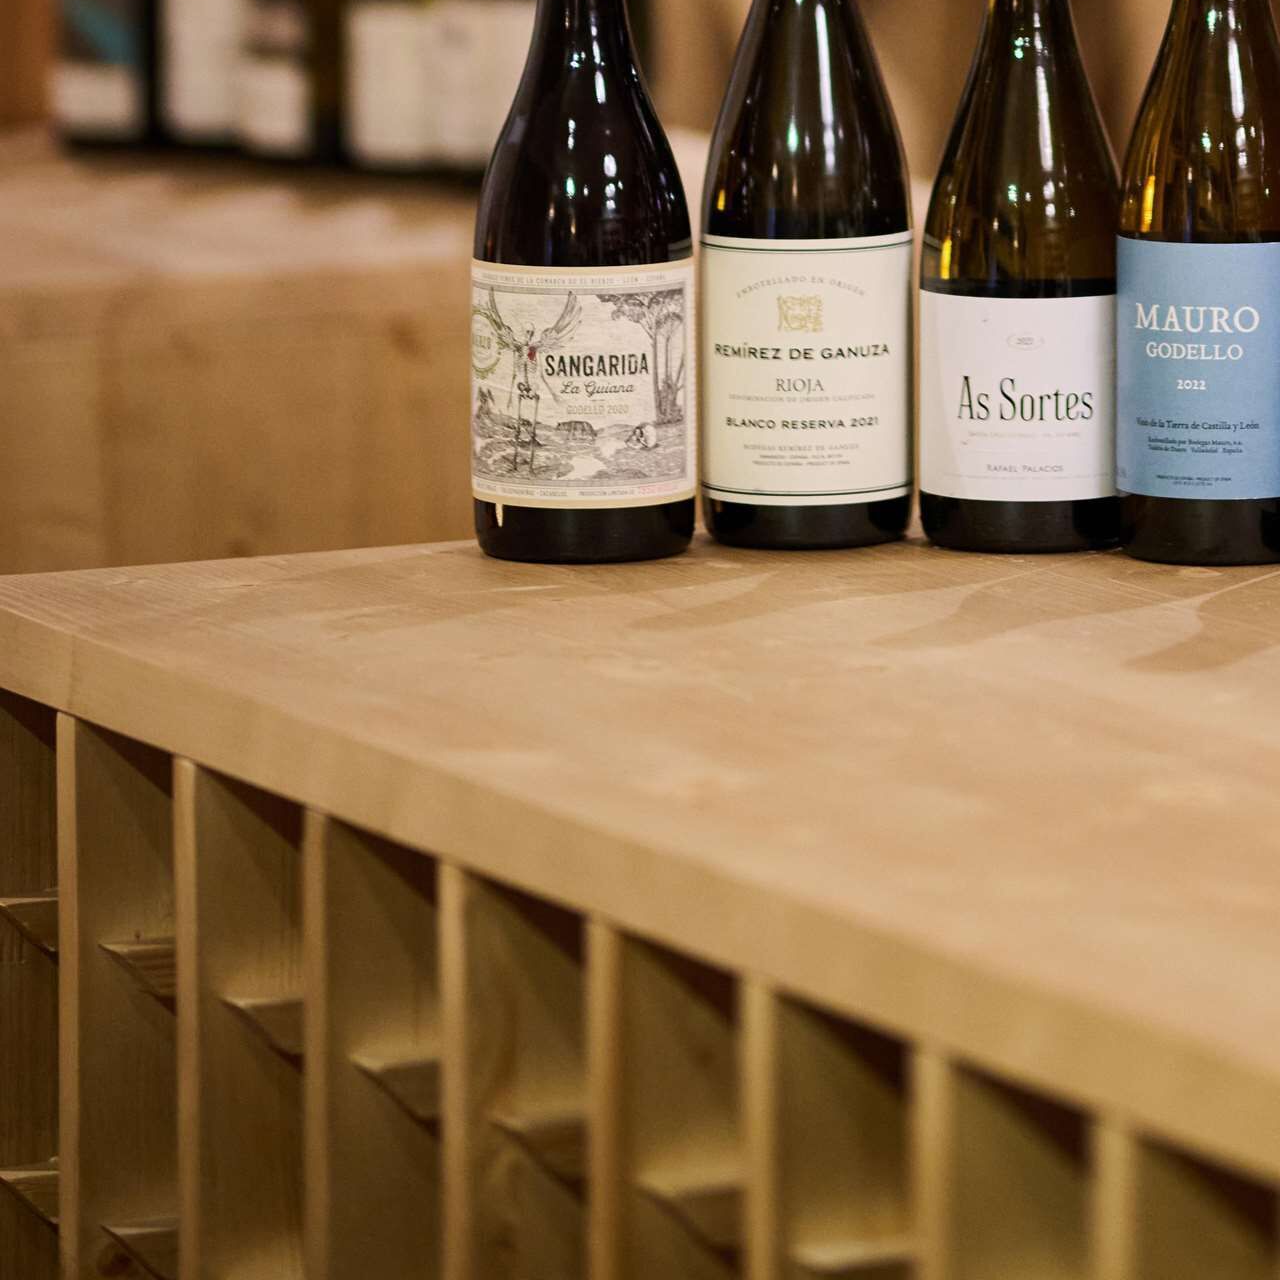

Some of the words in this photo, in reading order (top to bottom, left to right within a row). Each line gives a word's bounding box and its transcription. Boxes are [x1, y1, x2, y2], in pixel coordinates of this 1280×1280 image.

[1135, 302, 1261, 334] MAURO
[714, 342, 783, 361] REMÍREZ
[789, 347, 815, 361] DE
[820, 343, 890, 360] GANUZA
[1146, 342, 1244, 361] GODELLO
[545, 353, 649, 377] SANGARIDA
[560, 381, 580, 395] La
[775, 377, 825, 395] RIOJA
[1176, 379, 1207, 390] 2022
[958, 375, 991, 422] As
[999, 377, 1095, 422] Sortes
[725, 415, 777, 430] BLANCO
[781, 418, 846, 430] RESERVA
[850, 416, 879, 428] 2021
[1190, 421, 1201, 431] de
[1201, 420, 1232, 431] Castilla
[1232, 423, 1239, 433] y
[1240, 420, 1261, 431] León
[987, 463, 1019, 473] RAFAEL
[1022, 464, 1065, 473] PALACIOS
